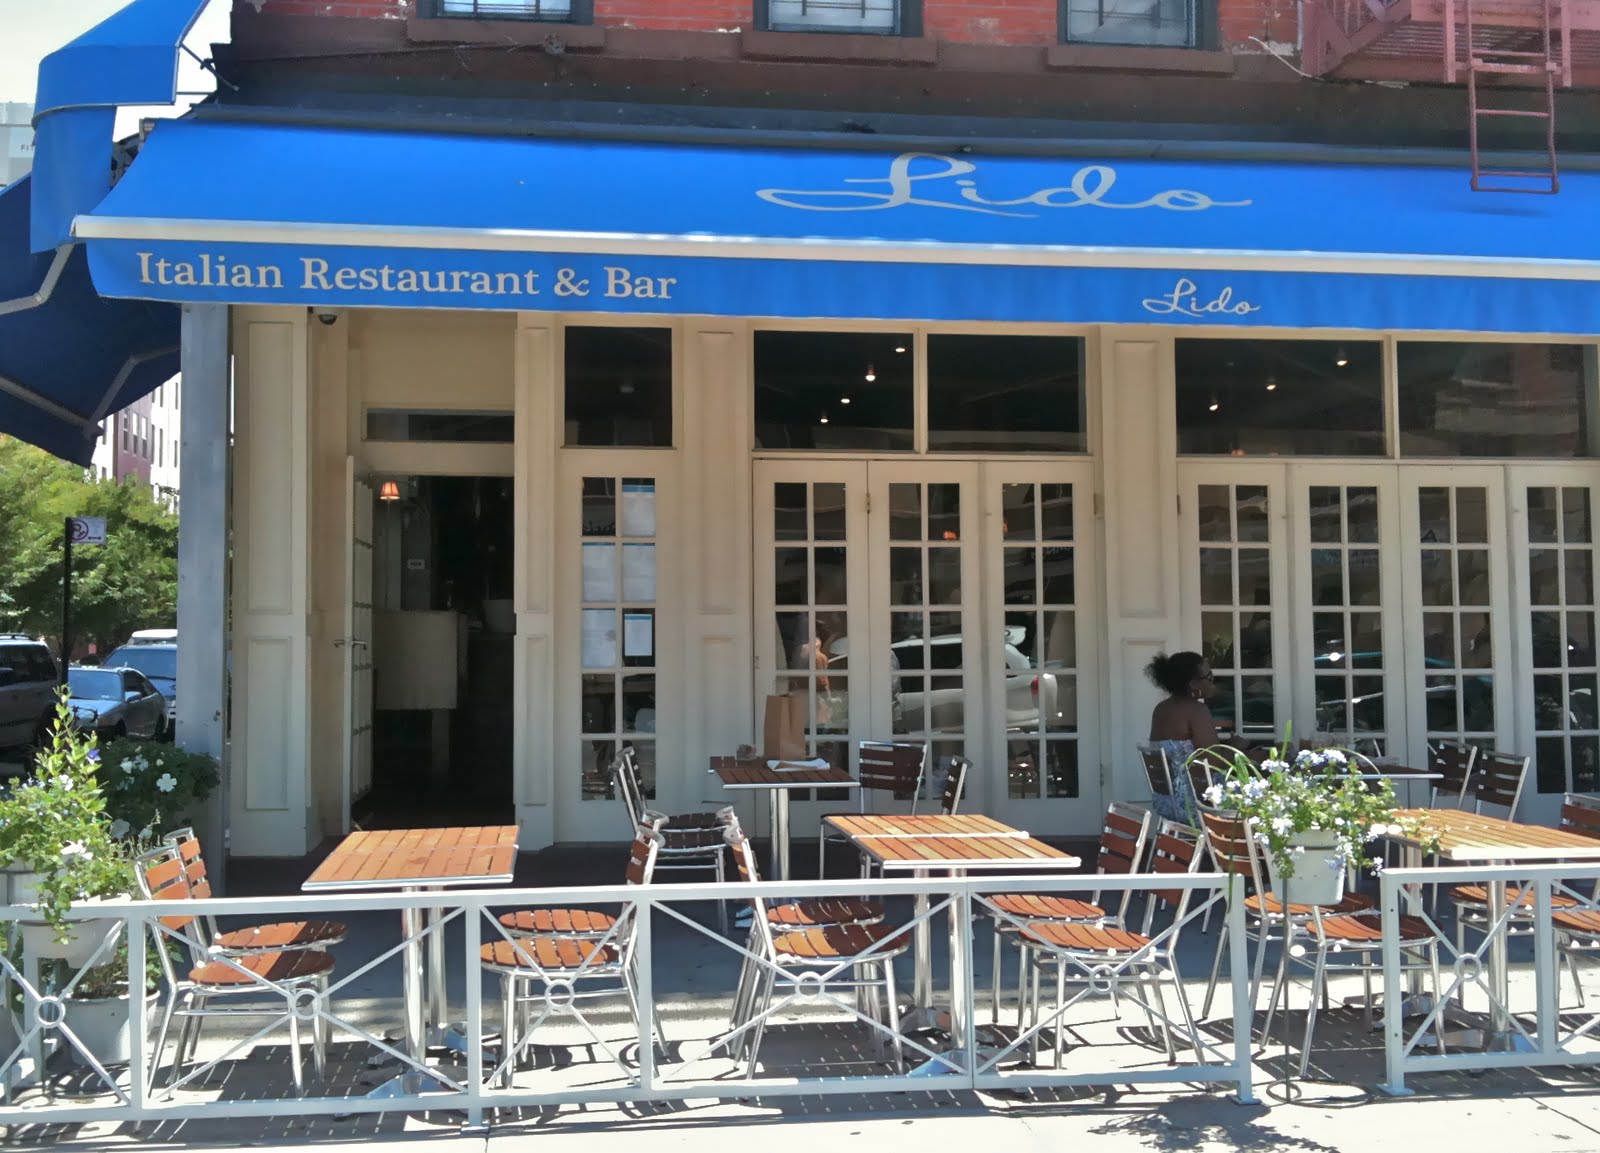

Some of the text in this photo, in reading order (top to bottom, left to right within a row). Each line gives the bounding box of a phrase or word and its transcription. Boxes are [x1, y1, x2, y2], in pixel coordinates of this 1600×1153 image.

[756, 152, 1254, 218] Lido
[136, 251, 678, 299] Italian Restaurant & Bar
[1143, 277, 1261, 318] Lido
